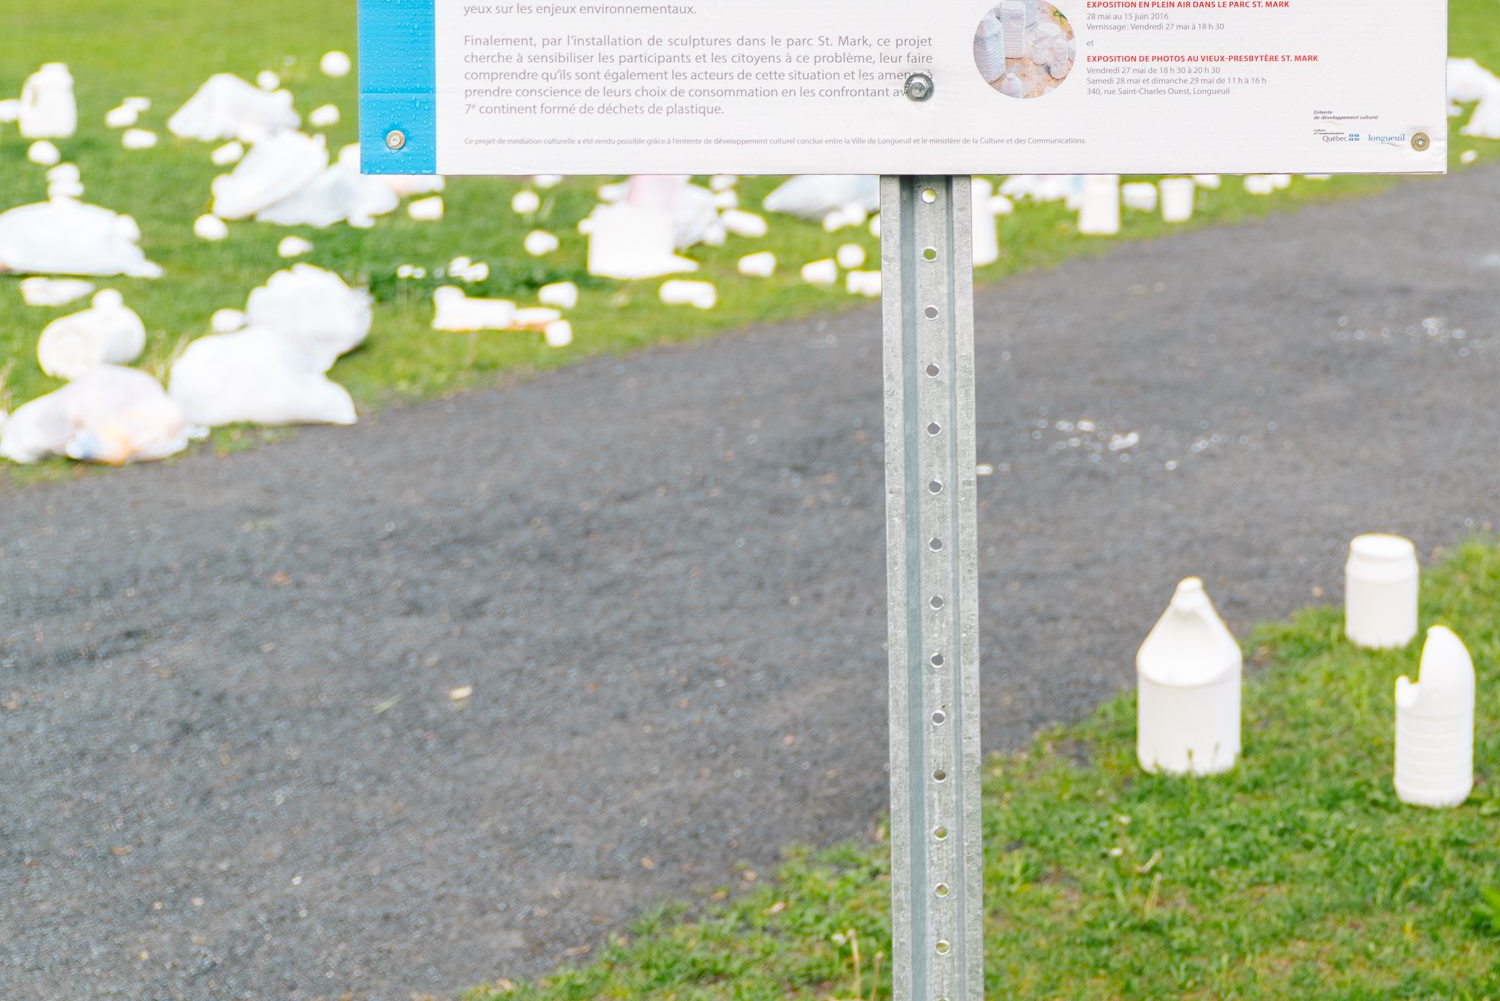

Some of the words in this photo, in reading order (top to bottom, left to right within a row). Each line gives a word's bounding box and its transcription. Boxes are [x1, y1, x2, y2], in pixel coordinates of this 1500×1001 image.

[1134, 13, 1149, 21] juin
[464, 35, 537, 47] Finalement,
[542, 38, 562, 49] par
[567, 35, 642, 46] l’installation
[647, 35, 663, 46] de
[668, 35, 732, 49] sculptures
[736, 35, 766, 46] dans
[771, 35, 782, 46] le
[786, 38, 813, 49] parc
[818, 35, 833, 46] St.
[838, 35, 872, 48] Mark,
[877, 38, 891, 47] ce
[895, 36, 932, 49] projet
[1200, 54, 1279, 62] VIEUX-PRESBYTÈRE
[1170, 66, 1175, 74] h
[1193, 66, 1203, 74] 20
[1204, 66, 1210, 74] h
[1211, 66, 1221, 74] 30
[1087, 88, 1102, 96] 340,
[1118, 87, 1166, 95] Saint-Charles
[1167, 87, 1192, 95] Ouest,
[1193, 87, 1230, 97] Longueuil
[1322, 135, 1348, 143] Québec
[1368, 134, 1405, 142] longueuil
